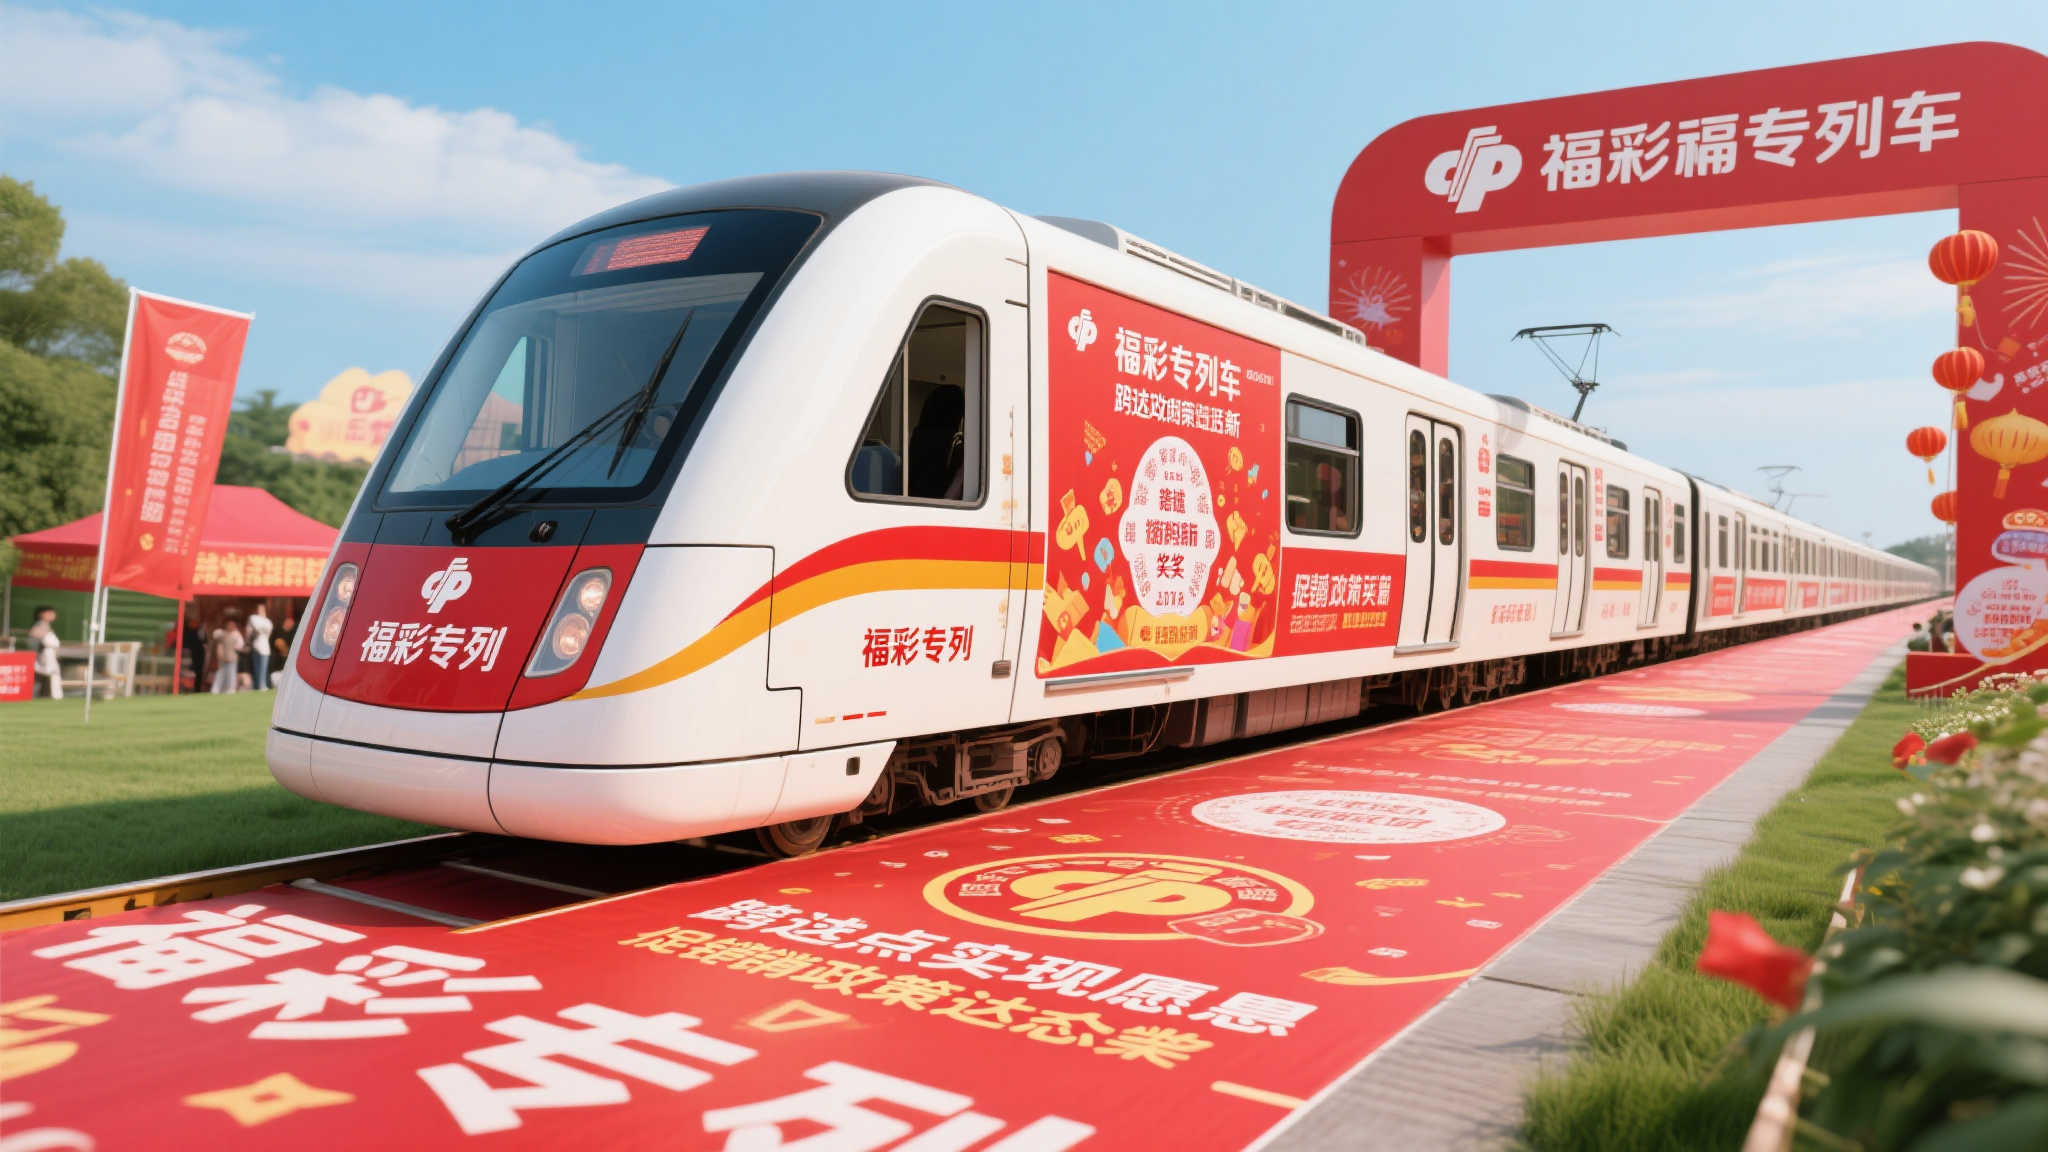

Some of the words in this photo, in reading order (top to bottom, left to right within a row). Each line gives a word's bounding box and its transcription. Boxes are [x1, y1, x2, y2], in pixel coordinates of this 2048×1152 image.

[1115, 326, 1242, 402] 福彩专列车
[360, 620, 508, 672] 福彩专列
[862, 626, 974, 668] 福彩专列
